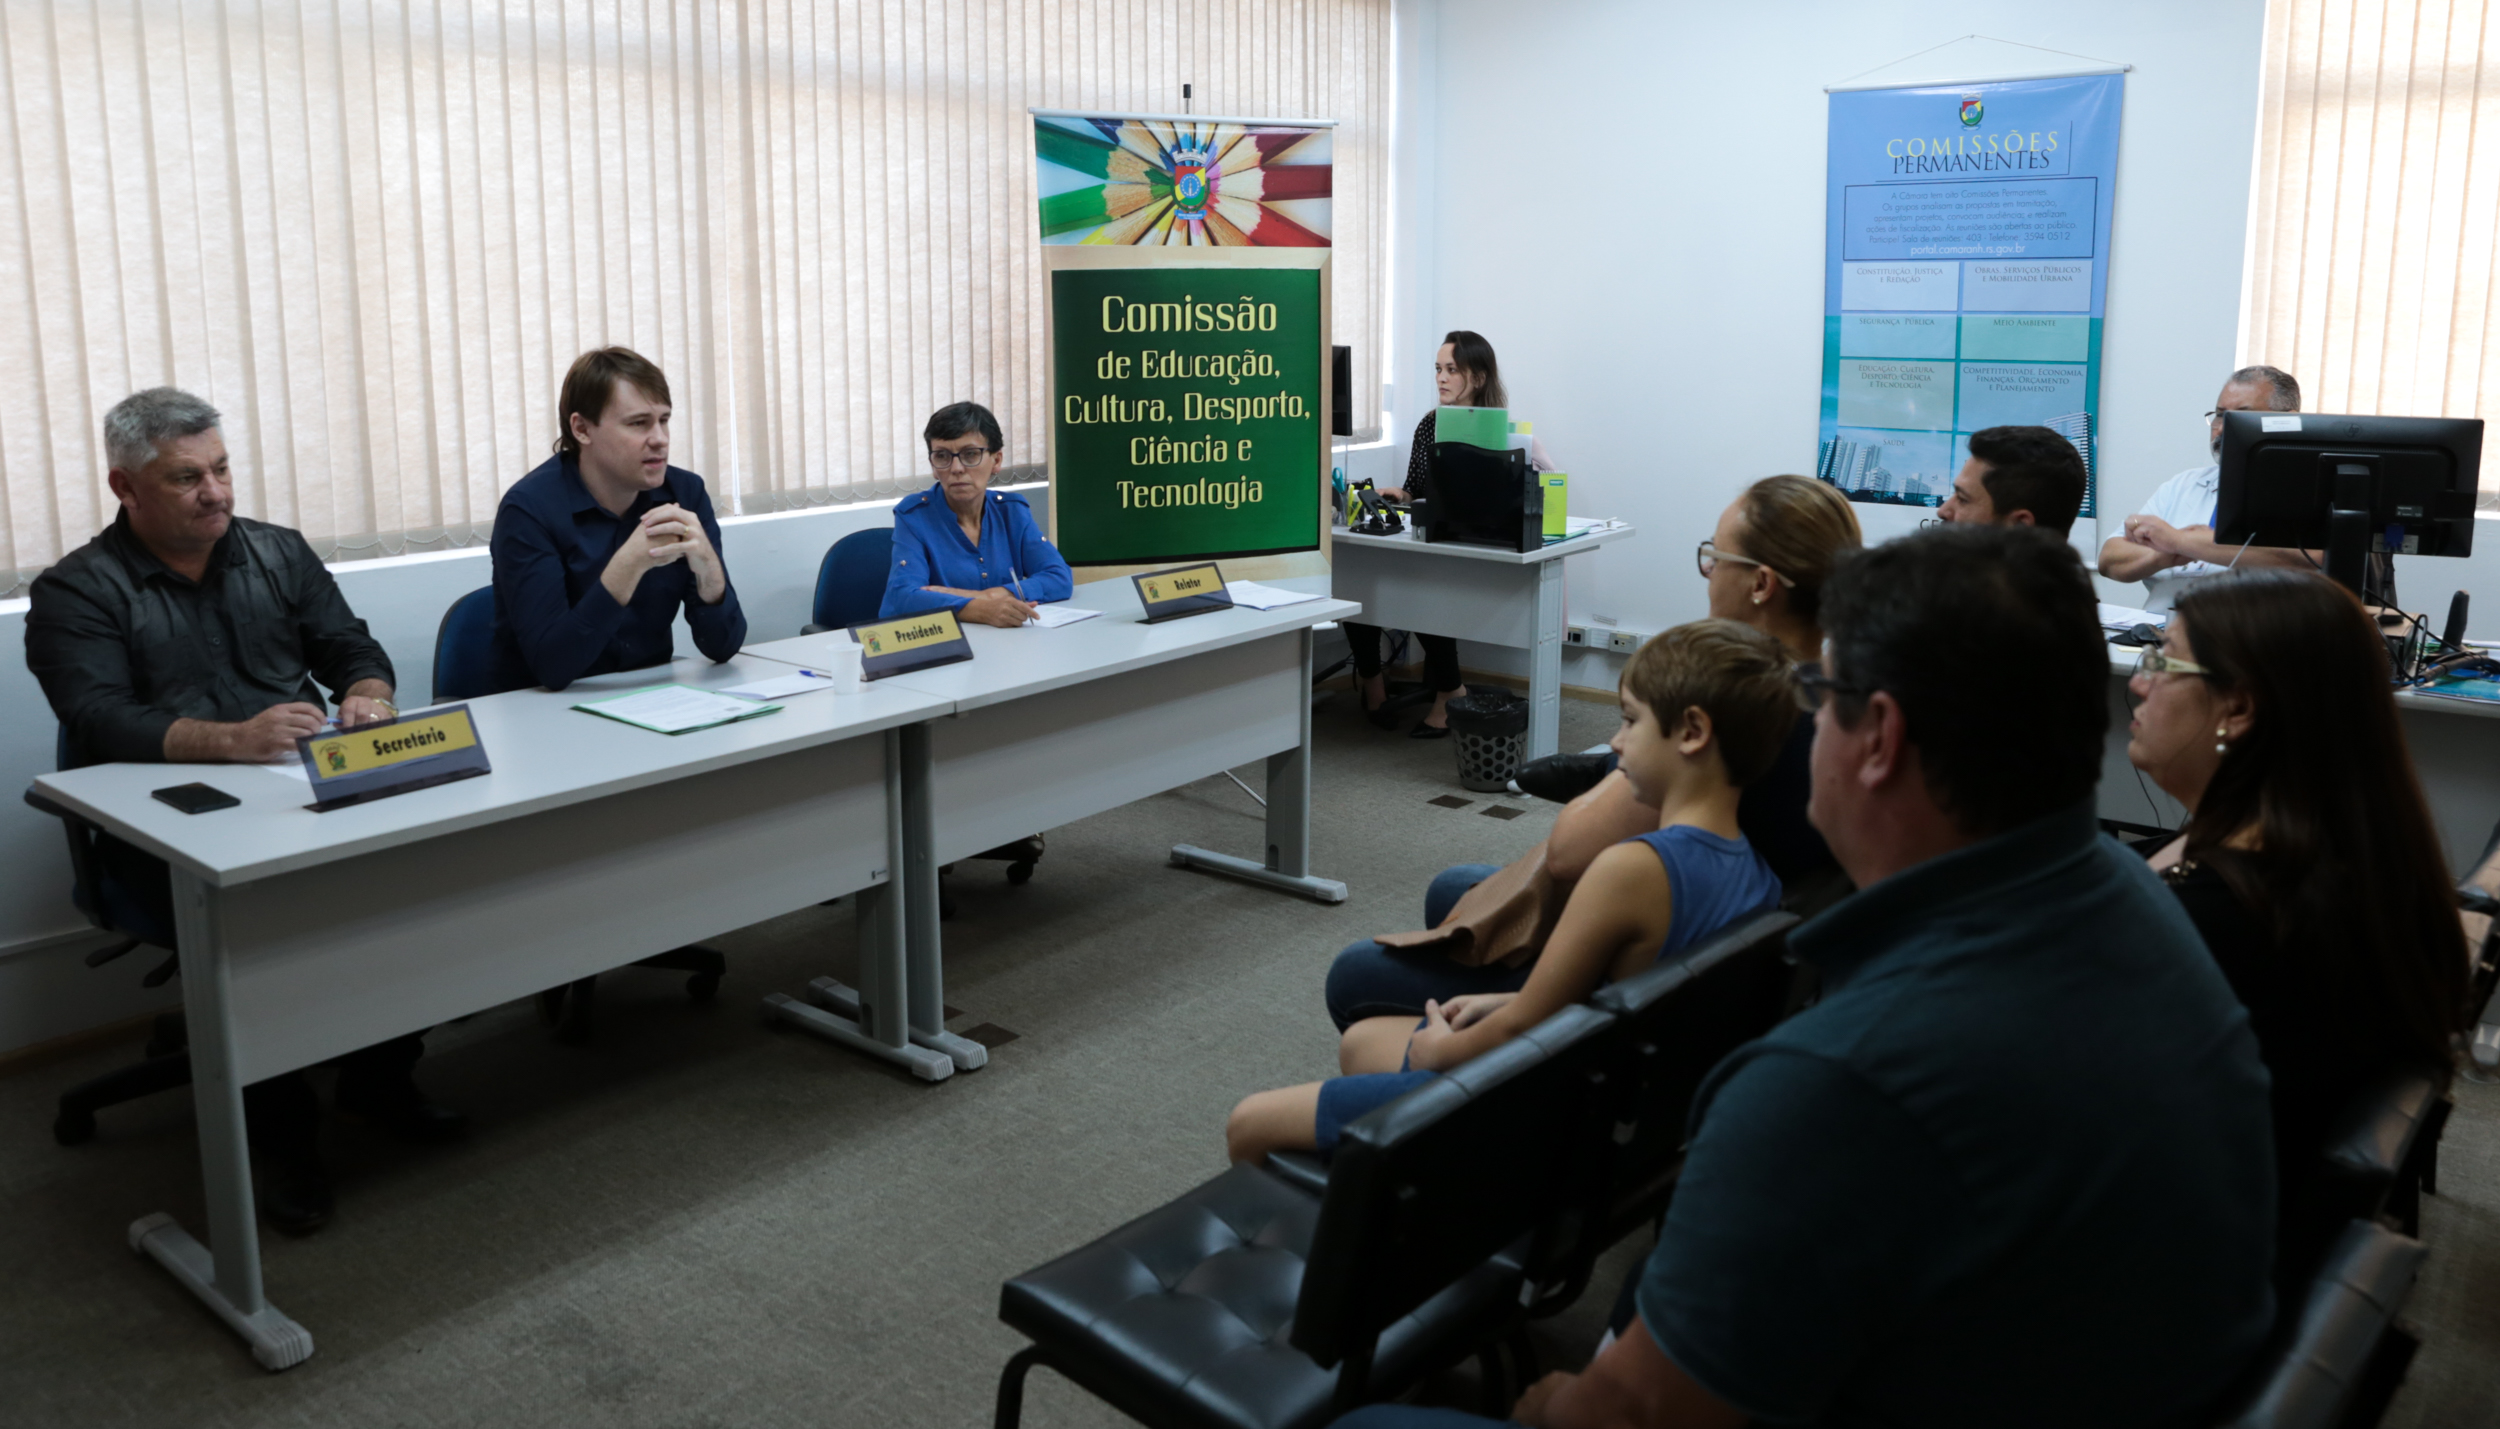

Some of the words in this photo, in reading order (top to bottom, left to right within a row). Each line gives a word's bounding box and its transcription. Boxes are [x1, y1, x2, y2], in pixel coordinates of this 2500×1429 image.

[1886, 130, 2058, 158] COMISSÕES
[1893, 149, 2050, 174] PERMANENTES
[1945, 191, 1958, 199] oito
[1961, 189, 1999, 198] Comissões
[2002, 188, 2047, 197] Permanentes.
[1882, 203, 1892, 211] Os
[1895, 203, 1919, 213] grupos
[1921, 202, 1953, 211] analisam
[1966, 201, 2000, 211] propostas
[1874, 214, 1912, 223] apresentam
[1986, 211, 2024, 220] audiências
[2035, 210, 2066, 218] realizam
[1866, 225, 1886, 233] ações
[1888, 224, 1897, 232] de
[1957, 222, 1985, 231] reuniões
[1988, 222, 2001, 230] são
[2005, 221, 2032, 230] abertas
[1902, 234, 1918, 243] Sala
[1920, 234, 1929, 242] de
[1966, 233, 1981, 241] 403
[2024, 232, 2044, 240] 3594
[2048, 231, 2070, 240] 0512
[1911, 243, 2025, 257] portal.camaranh.rs.gov.br
[1914, 267, 1943, 276] JUSTIÇA
[2004, 266, 2040, 275] SERVIÇOS
[2044, 264, 2081, 274] PÚBLICOS
[1886, 275, 1921, 284] REDAÇÃO
[2040, 274, 2073, 282] URBANA
[1102, 293, 1277, 333] Comissão
[1859, 318, 1900, 326] SEGURANÇA
[1904, 317, 1935, 326] PÚBLICA
[2017, 319, 2056, 327] AMBIENTE
[1096, 351, 1130, 380] de
[1141, 350, 1281, 385] Educação,
[1901, 372, 1931, 381] CIÊNCIA
[2018, 376, 2069, 385] ORÇAMENTO
[1876, 381, 1921, 389] TECNOLOGIA
[1995, 384, 2055, 393] PLANEJAMENTO
[1064, 395, 1173, 425] Cultura,
[1184, 391, 1311, 425] Desporto,
[1883, 438, 1905, 446] SAÚDE
[1130, 435, 1228, 466] Ciência
[1238, 439, 1252, 461] e
[1117, 475, 1263, 510] Tecnologia
[1174, 578, 1201, 591] Relator
[895, 622, 943, 643] Presidente
[372, 727, 446, 755] Secretário
